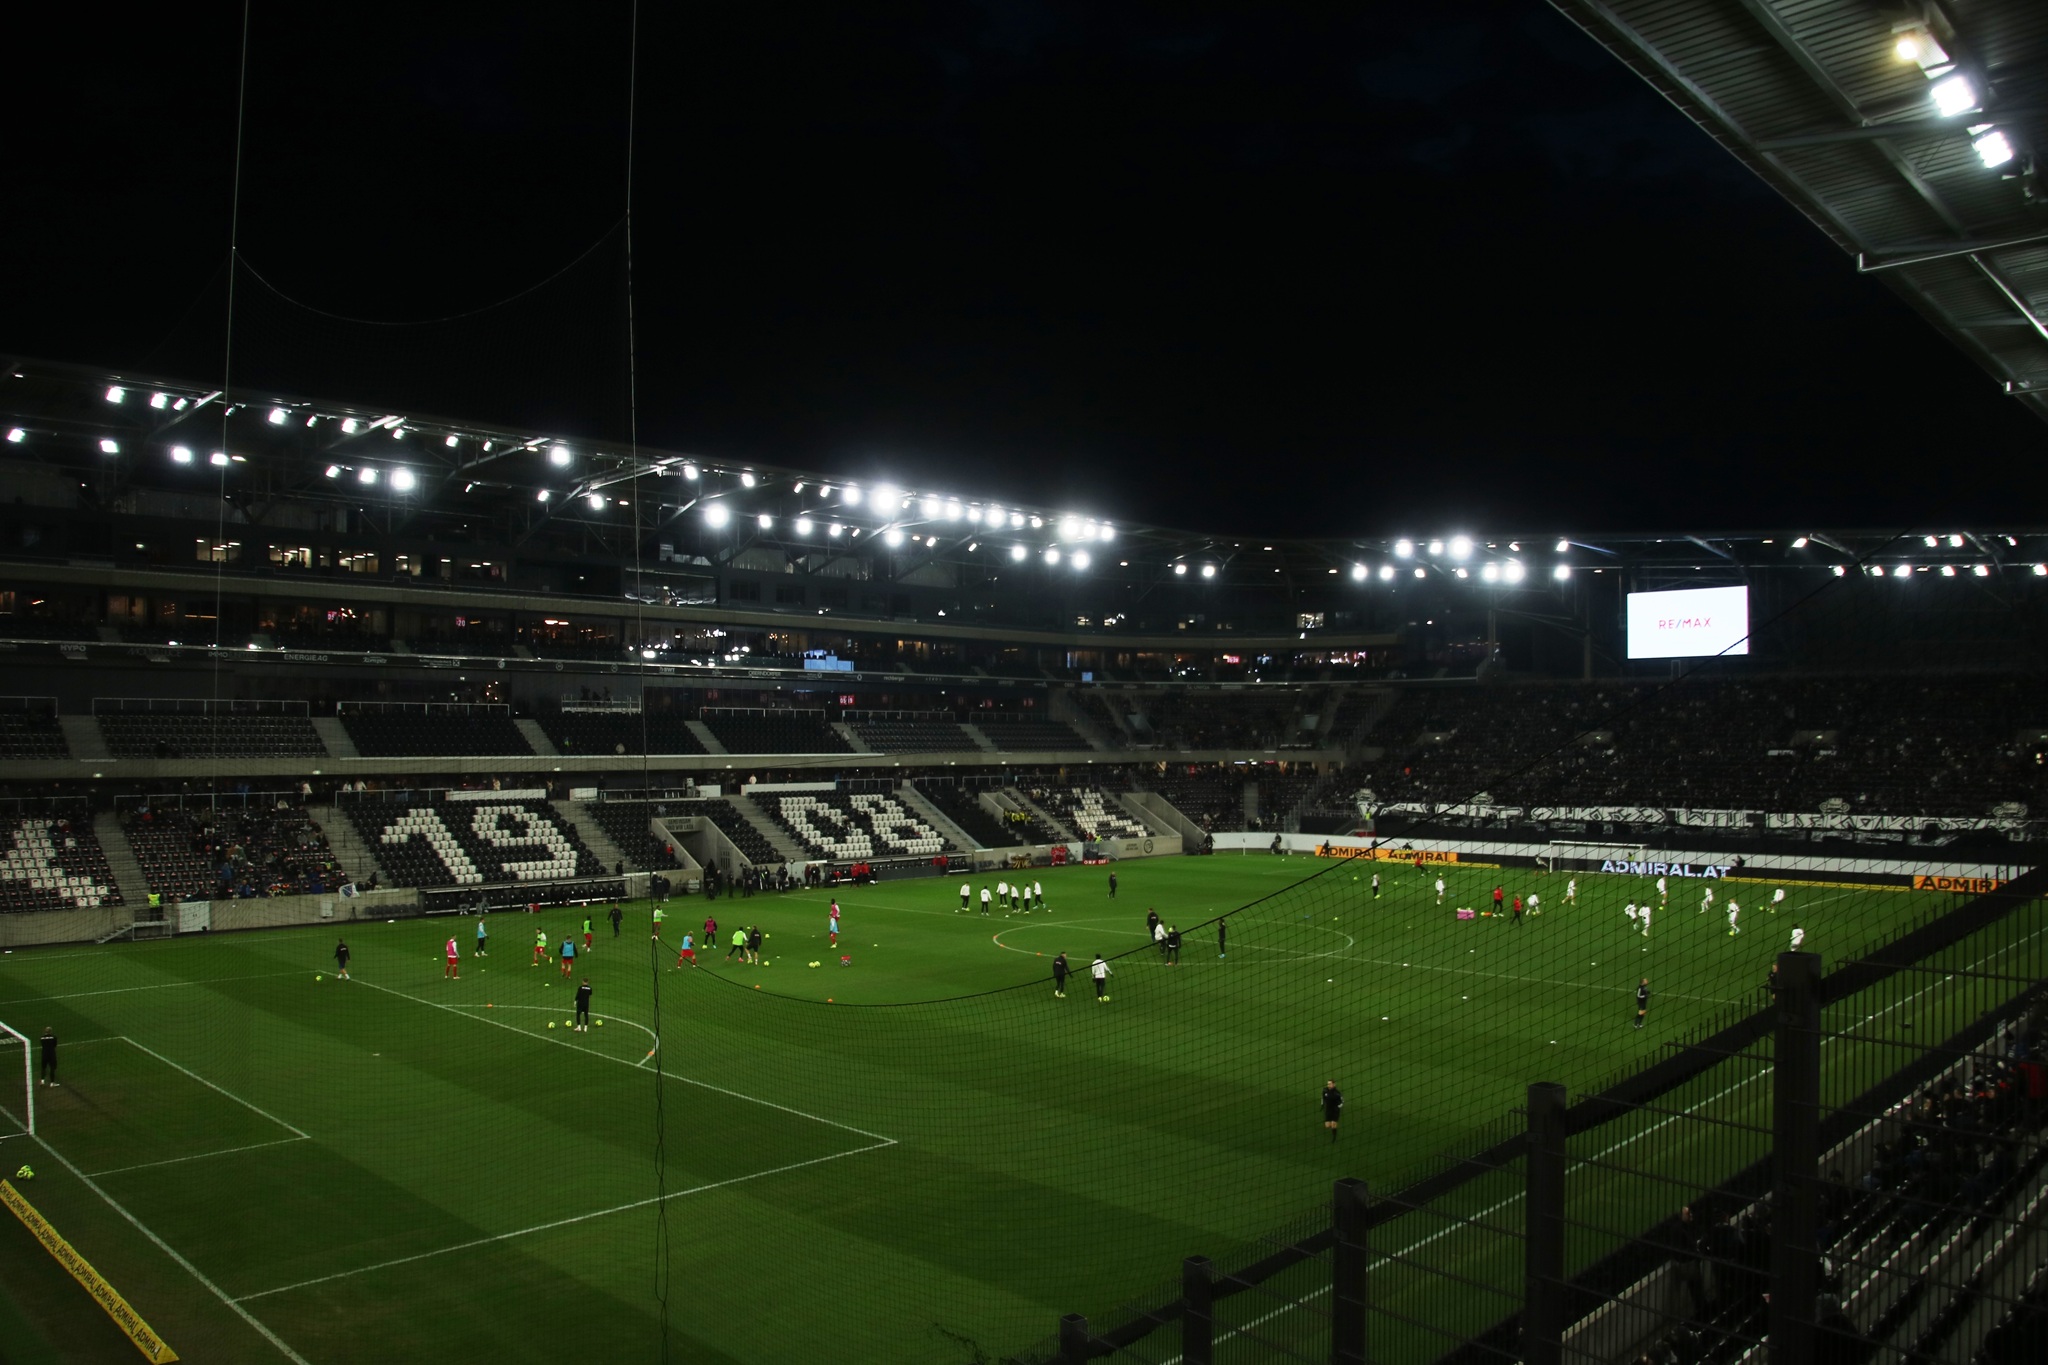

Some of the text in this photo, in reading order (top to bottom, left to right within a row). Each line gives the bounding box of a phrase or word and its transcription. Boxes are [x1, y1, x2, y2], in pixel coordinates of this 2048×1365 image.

[1659, 617, 1712, 630] RE/MAX
[60, 644, 87, 652] HYPO
[1319, 845, 1377, 860] ADMIRAL
[1601, 860, 1732, 878] ADMIRAL.AT
[1921, 876, 2006, 893] ADMIR
[115, 1304, 138, 1334] ADMIRAL
[136, 1329, 161, 1360] ADMIRAL
